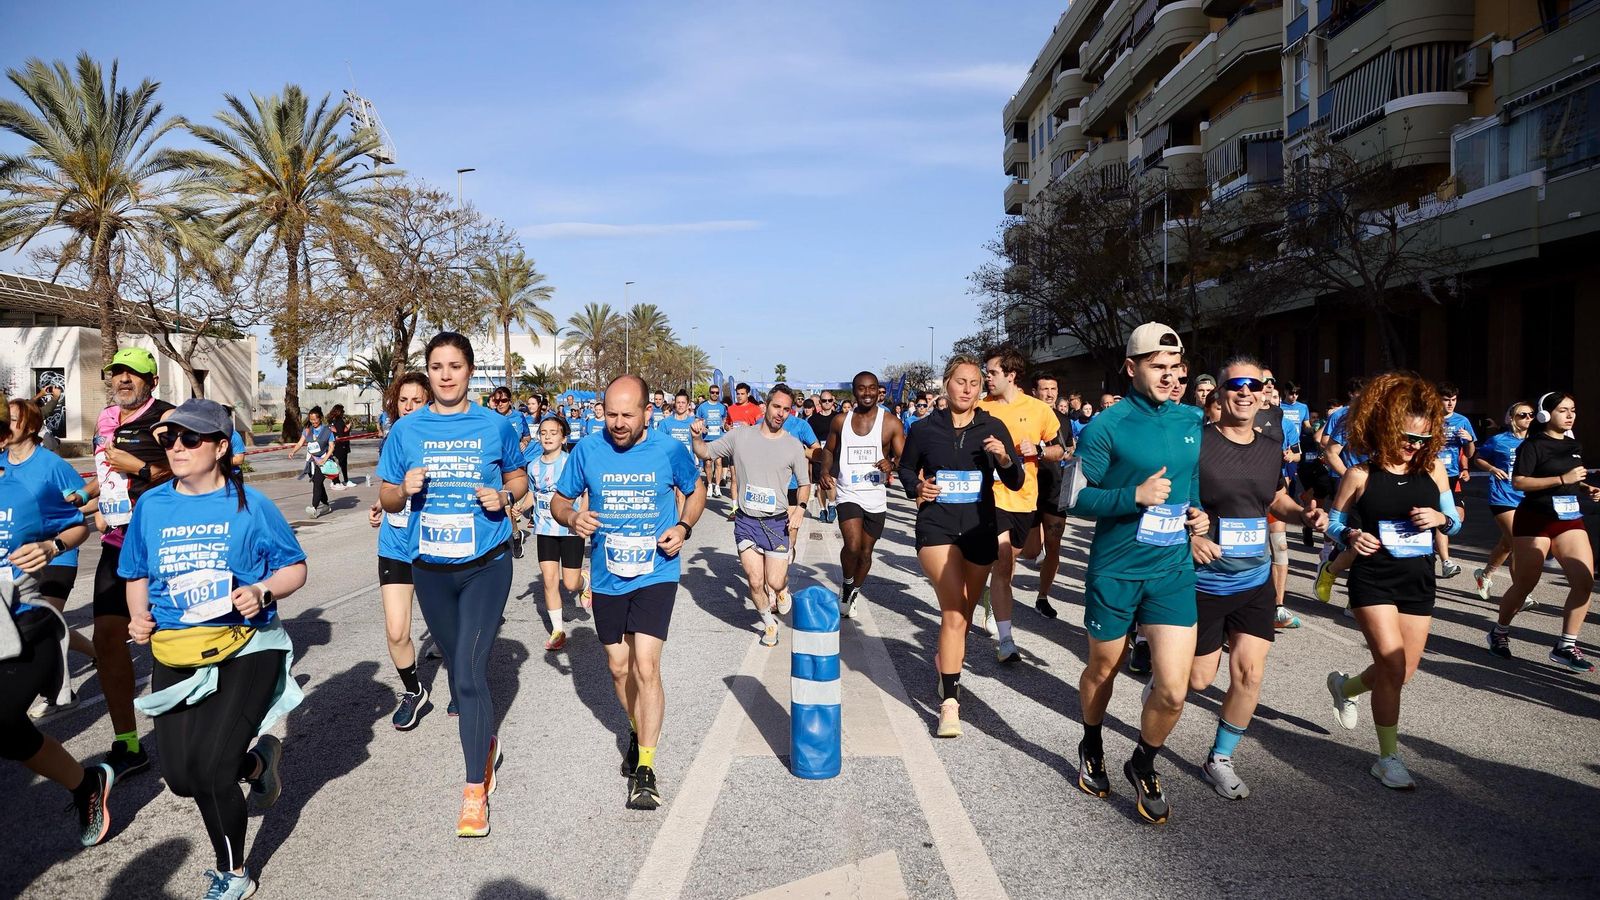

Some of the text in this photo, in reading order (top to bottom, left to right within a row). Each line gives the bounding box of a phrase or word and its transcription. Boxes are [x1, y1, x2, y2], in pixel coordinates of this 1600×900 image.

[424, 439, 482, 450] mayoral
[602, 472, 656, 484] mayoral
[949, 481, 970, 491] 913
[751, 493, 770, 503] 2805
[102, 501, 120, 513] 1977
[1160, 517, 1180, 530] 177
[162, 522, 229, 538] mayoral
[427, 528, 462, 541] 1737
[1235, 531, 1257, 542] 783
[613, 549, 647, 562] 2512
[184, 582, 218, 607] 1091
